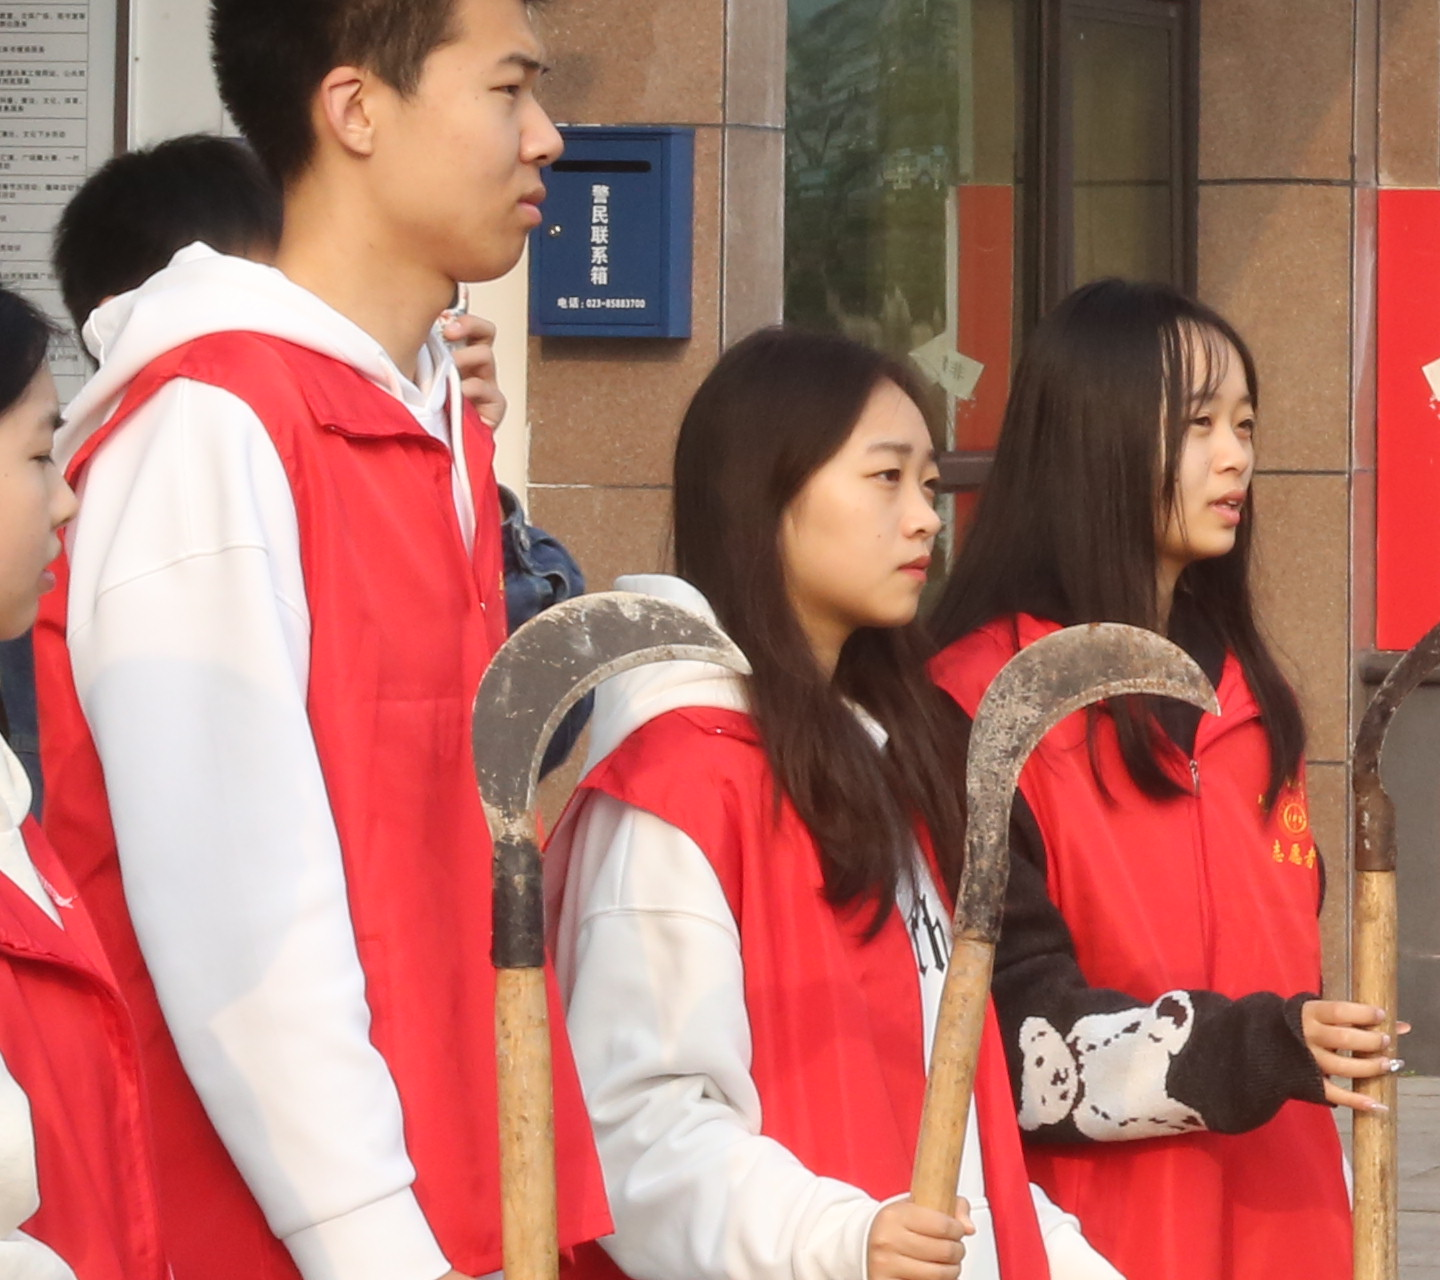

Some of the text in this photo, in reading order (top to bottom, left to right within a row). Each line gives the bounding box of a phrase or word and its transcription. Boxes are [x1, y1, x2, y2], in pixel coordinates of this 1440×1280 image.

[590, 184, 611, 286] 警民联系箱
